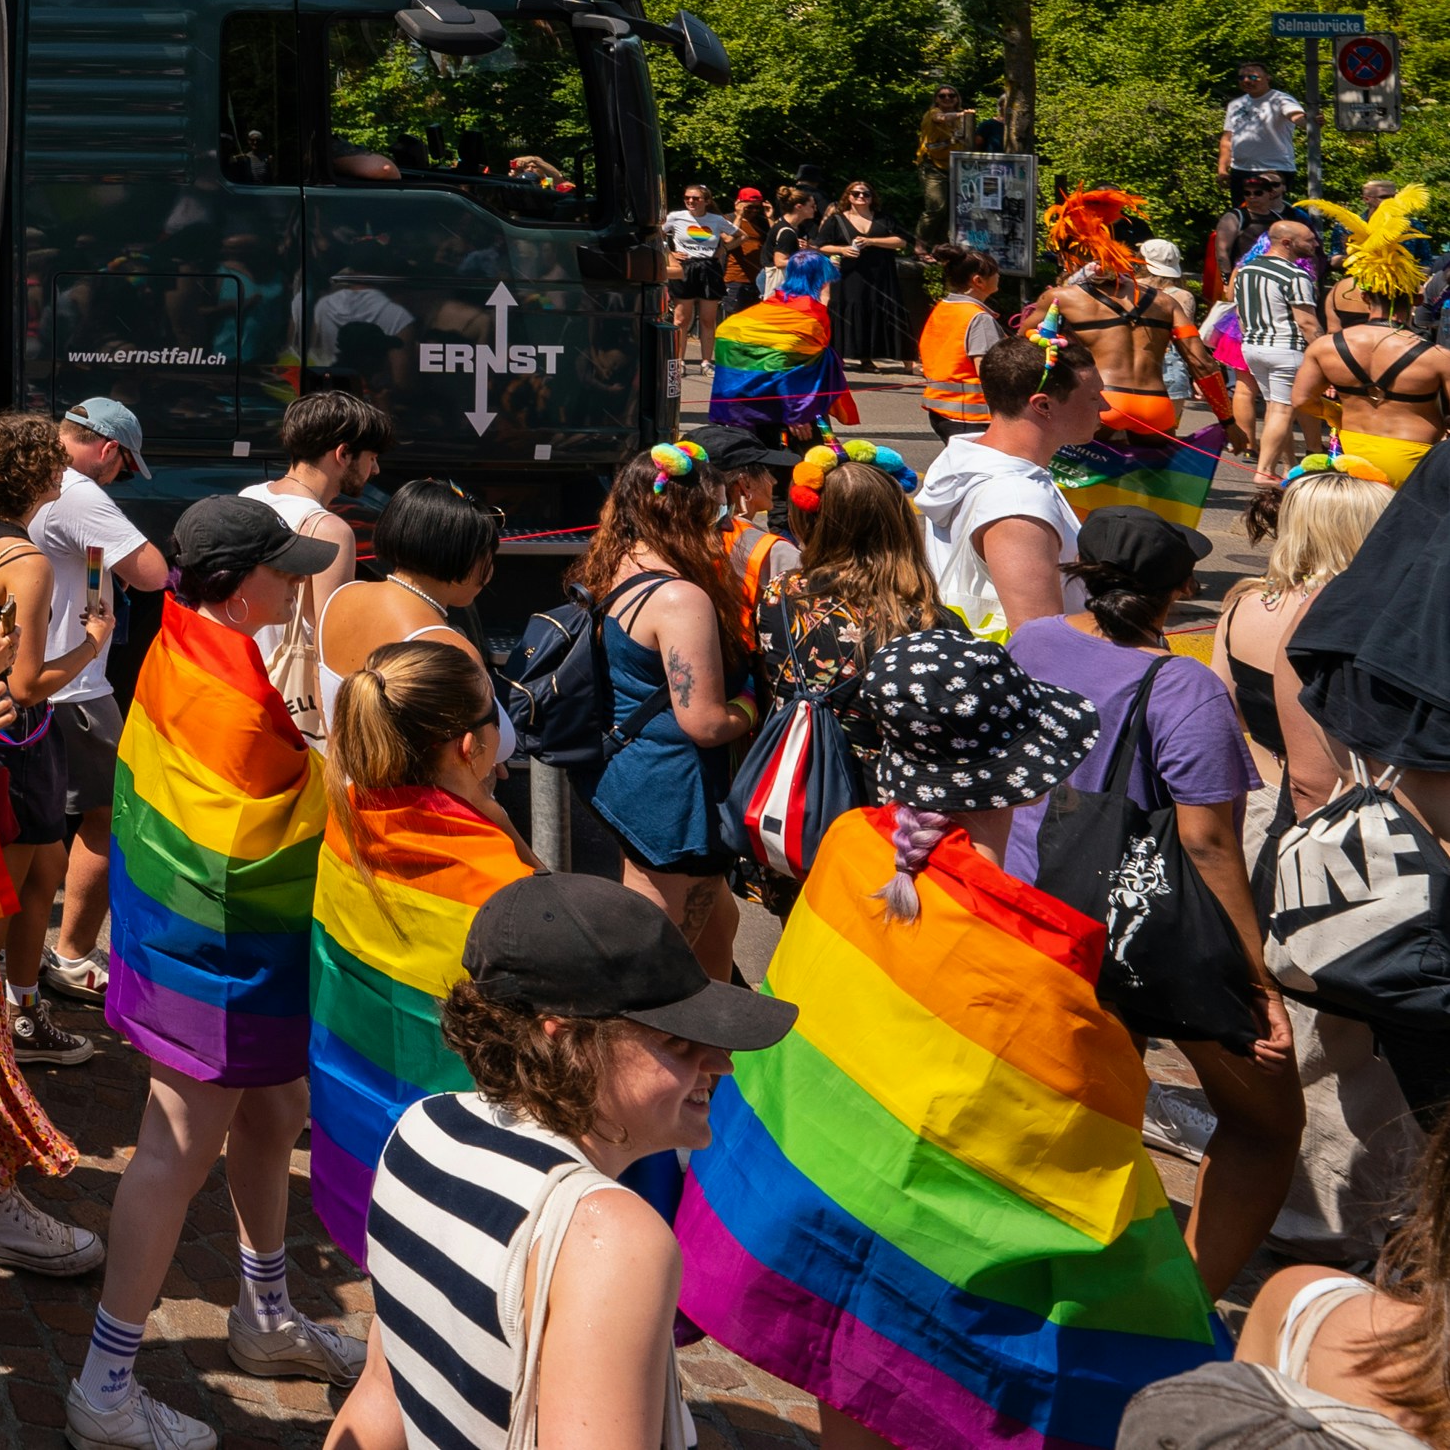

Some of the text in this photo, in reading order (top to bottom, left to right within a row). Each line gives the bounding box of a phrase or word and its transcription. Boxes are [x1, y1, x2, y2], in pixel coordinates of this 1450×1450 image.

[1277, 17, 1361, 33] Selnaubrücke
[67, 346, 228, 367] www.ernstfall.ch
[418, 344, 565, 375] ERNST
[1273, 802, 1430, 912] IKE
[258, 1306, 285, 1316] adidas
[101, 1382, 128, 1393] adidas
